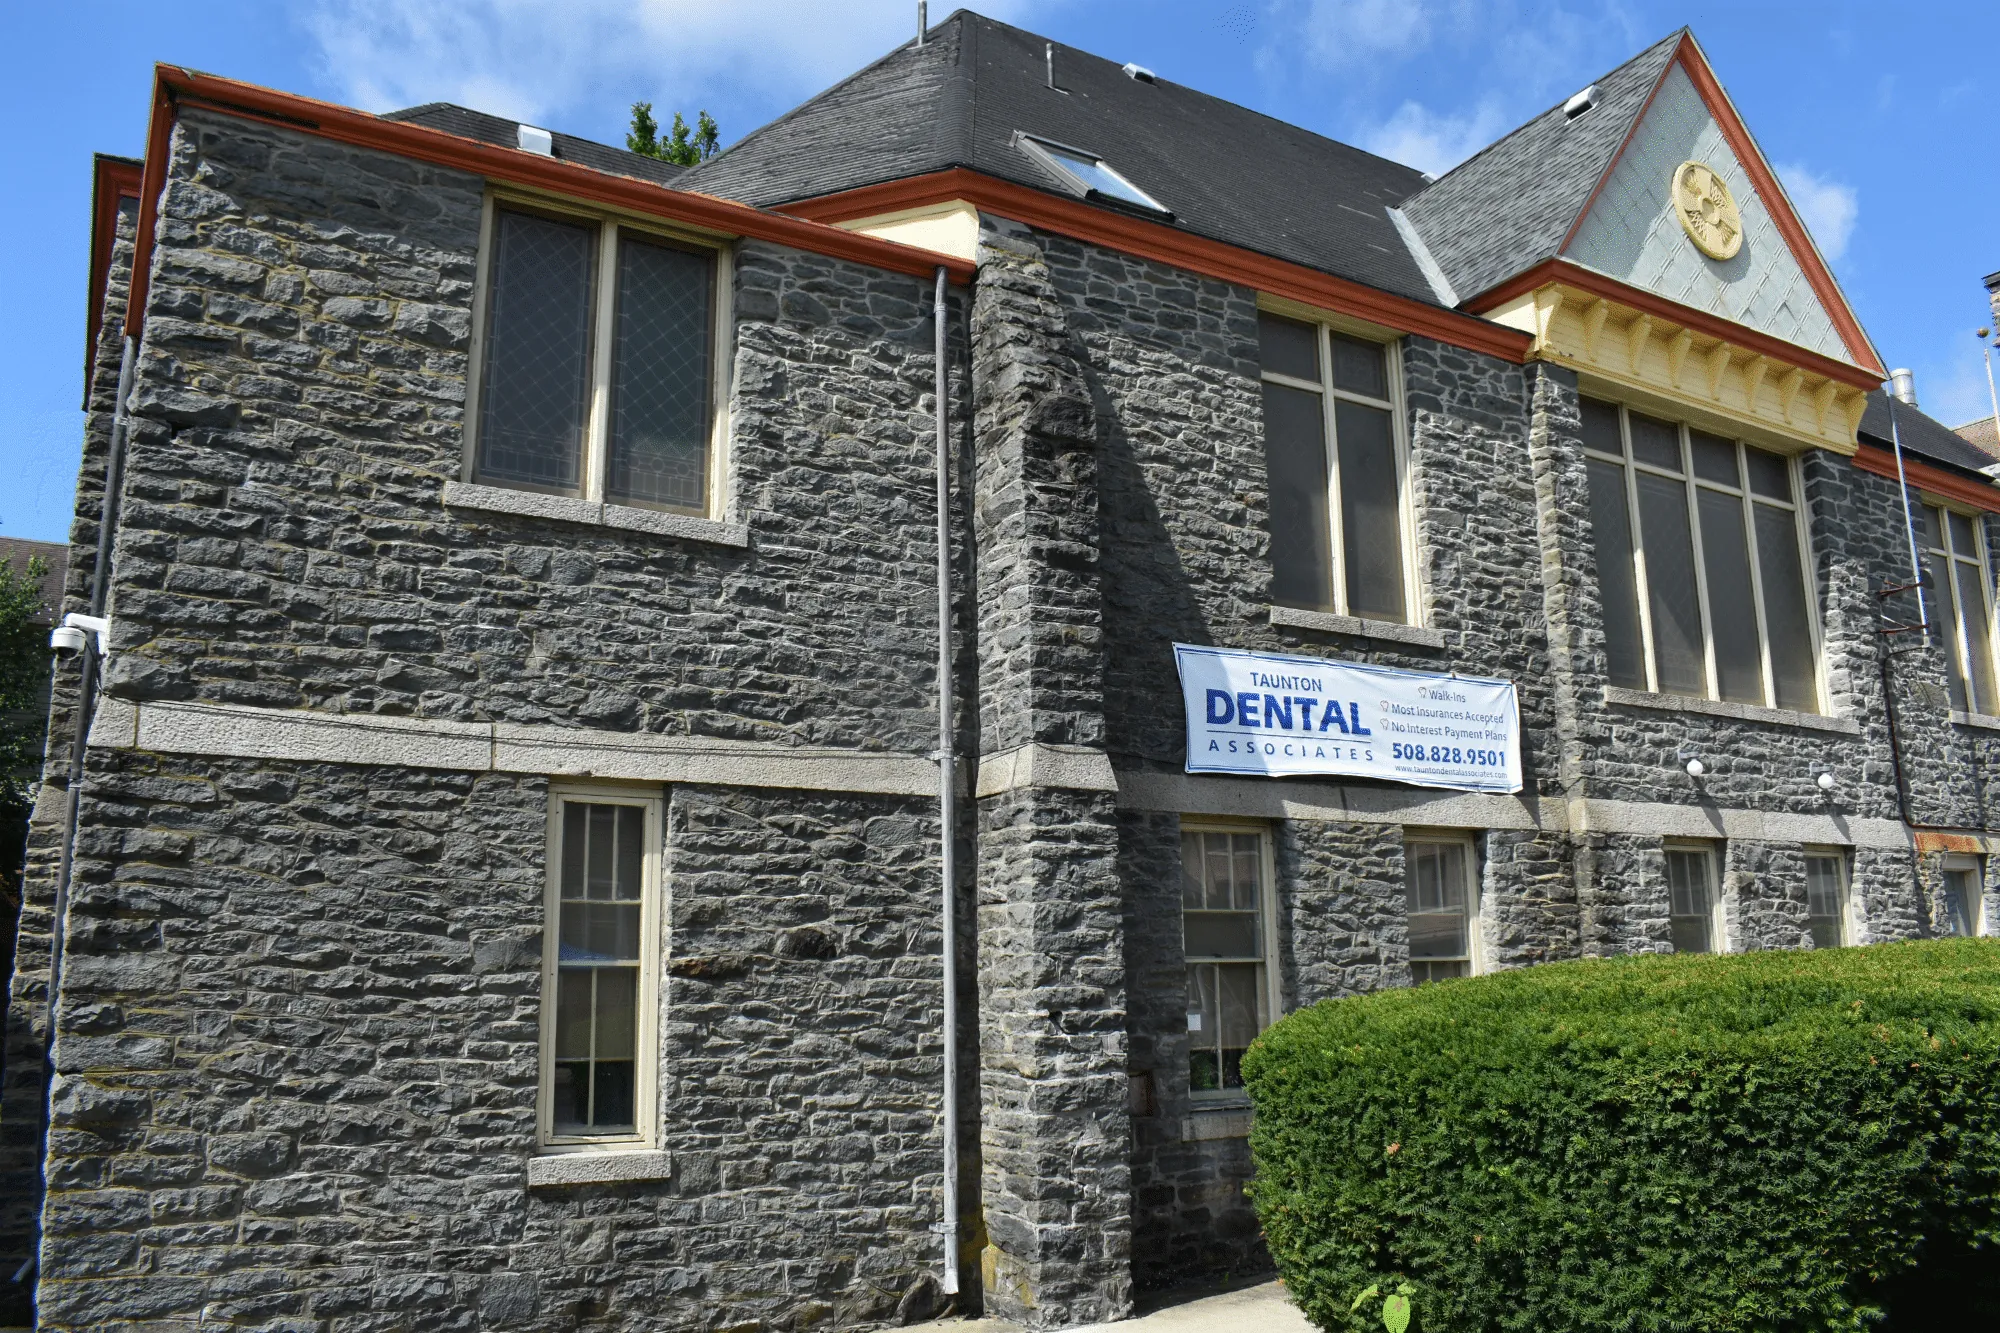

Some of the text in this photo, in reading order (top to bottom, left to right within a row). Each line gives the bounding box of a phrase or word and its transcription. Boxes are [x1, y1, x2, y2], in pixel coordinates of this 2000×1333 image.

[1250, 672, 1322, 692] TAUNTON
[1429, 689, 1466, 703] Walk-Ins
[1206, 688, 1372, 736] DENTAL
[1391, 703, 1504, 725] Most Insurances Accepted
[1391, 720, 1507, 741] No Interest Payment Plans
[1208, 739, 1373, 762] ASSOCIATES
[1392, 742, 1506, 767] 508.828.9501
[1395, 764, 1508, 779] www.tauntondentalassociates.com
